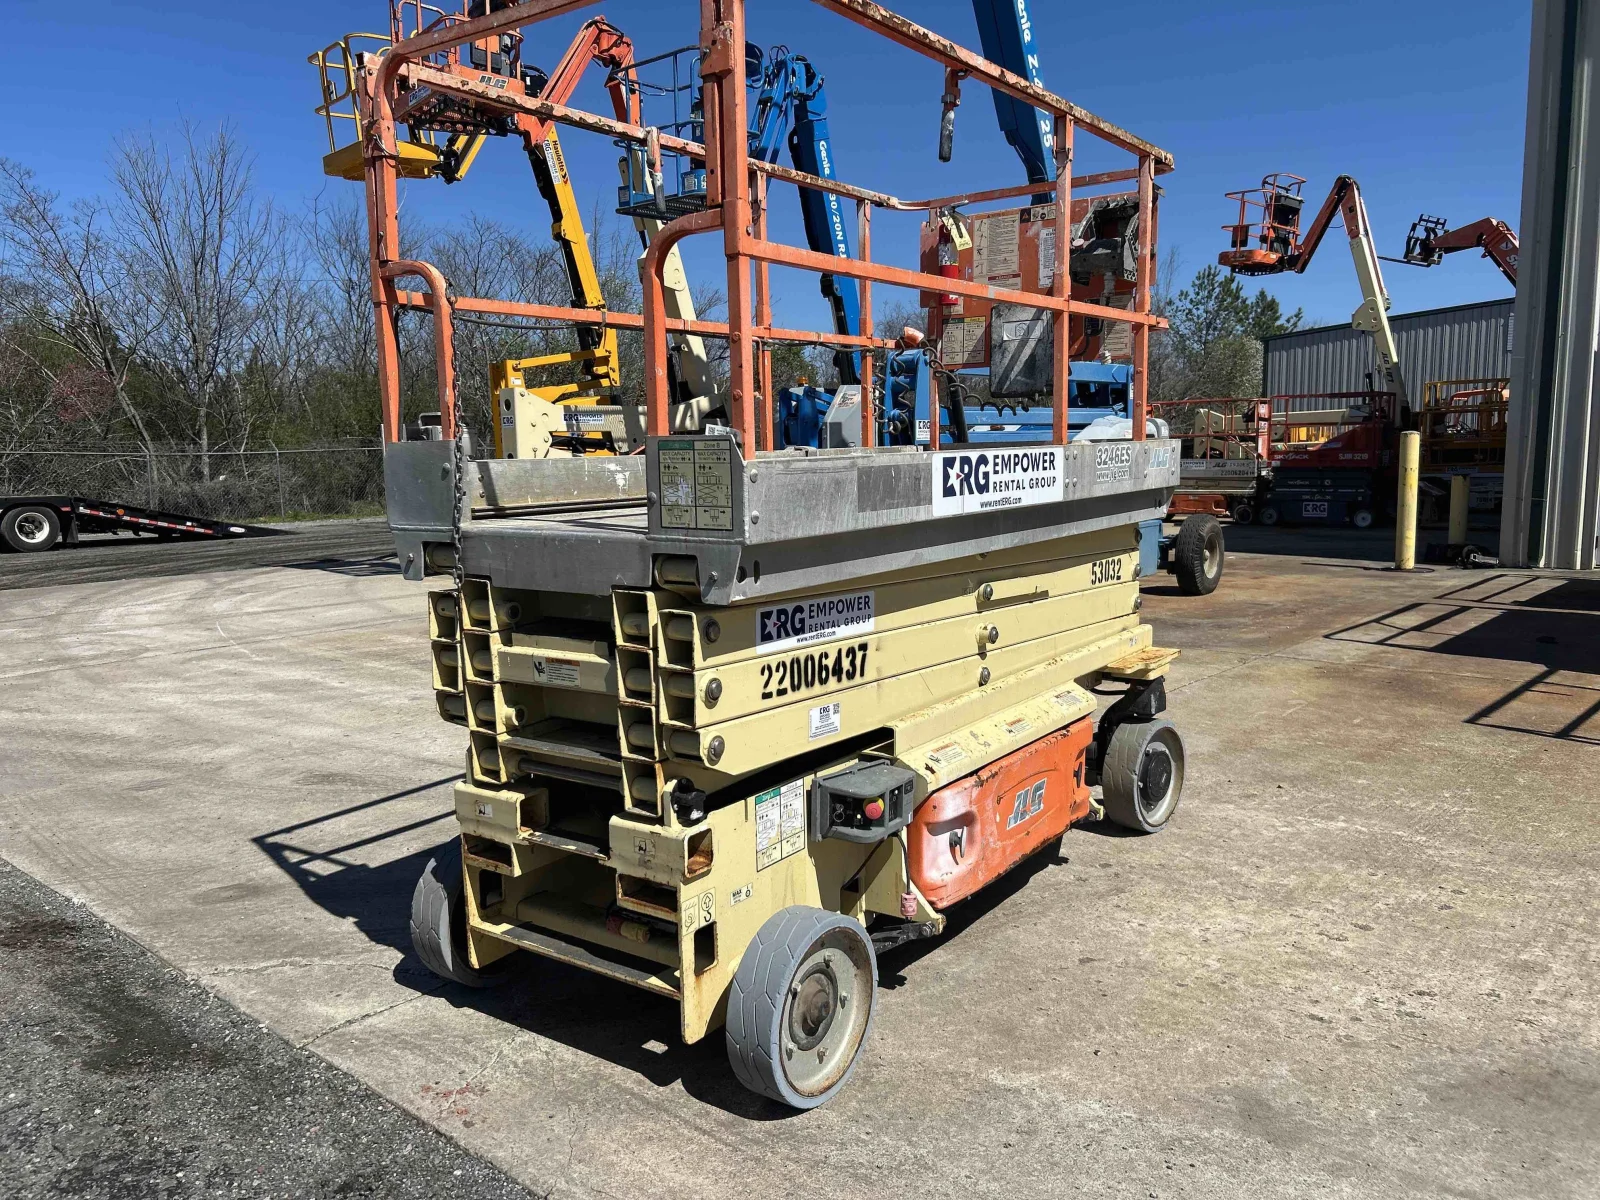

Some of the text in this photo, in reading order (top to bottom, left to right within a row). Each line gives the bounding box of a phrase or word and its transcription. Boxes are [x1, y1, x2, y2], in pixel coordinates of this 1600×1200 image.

[1017, 0, 1031, 44] enie
[480, 75, 507, 89] JLG
[552, 140, 565, 173] Haulotte
[820, 140, 831, 177] Genie
[1096, 445, 1132, 468] 3246ES
[943, 451, 1056, 498] ERG EMPOWER
[993, 475, 1057, 493] RENTAL GROUP
[980, 496, 1023, 509] www.rentERG.com
[1304, 503, 1327, 513] ERG
[1091, 558, 1122, 585] 53032
[760, 595, 871, 642] ERG EMPOWER
[808, 614, 872, 634] RENTAL GROUP
[796, 630, 836, 644] www.rentERG.com
[760, 642, 868, 700] 22006437
[819, 705, 831, 714] ERG
[1006, 777, 1047, 830] JLG
[732, 889, 742, 897] MAX
